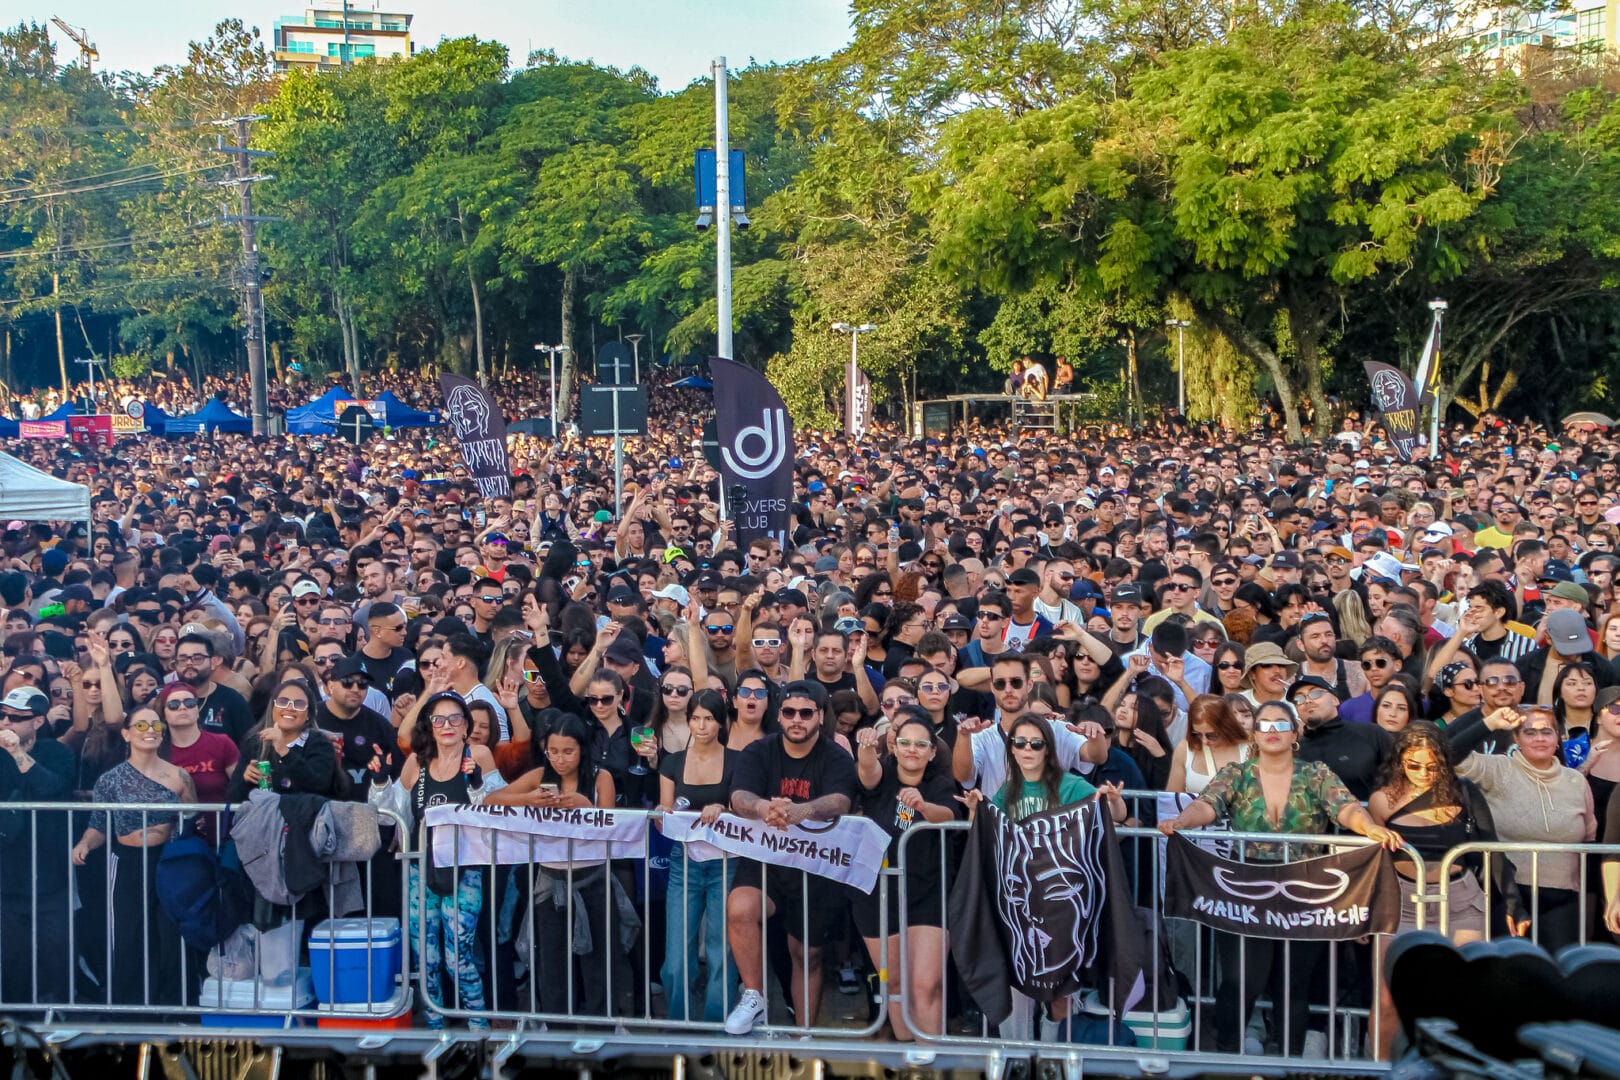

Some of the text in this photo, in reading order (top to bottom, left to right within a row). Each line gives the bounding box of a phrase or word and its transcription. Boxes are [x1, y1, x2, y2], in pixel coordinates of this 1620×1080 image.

[417, 767, 427, 809] SEPHORA
[524, 804, 615, 828] MUSTACHE
[760, 830, 852, 866] MUSTACHE
[1192, 895, 1370, 931] MALIK MUSTACHE
